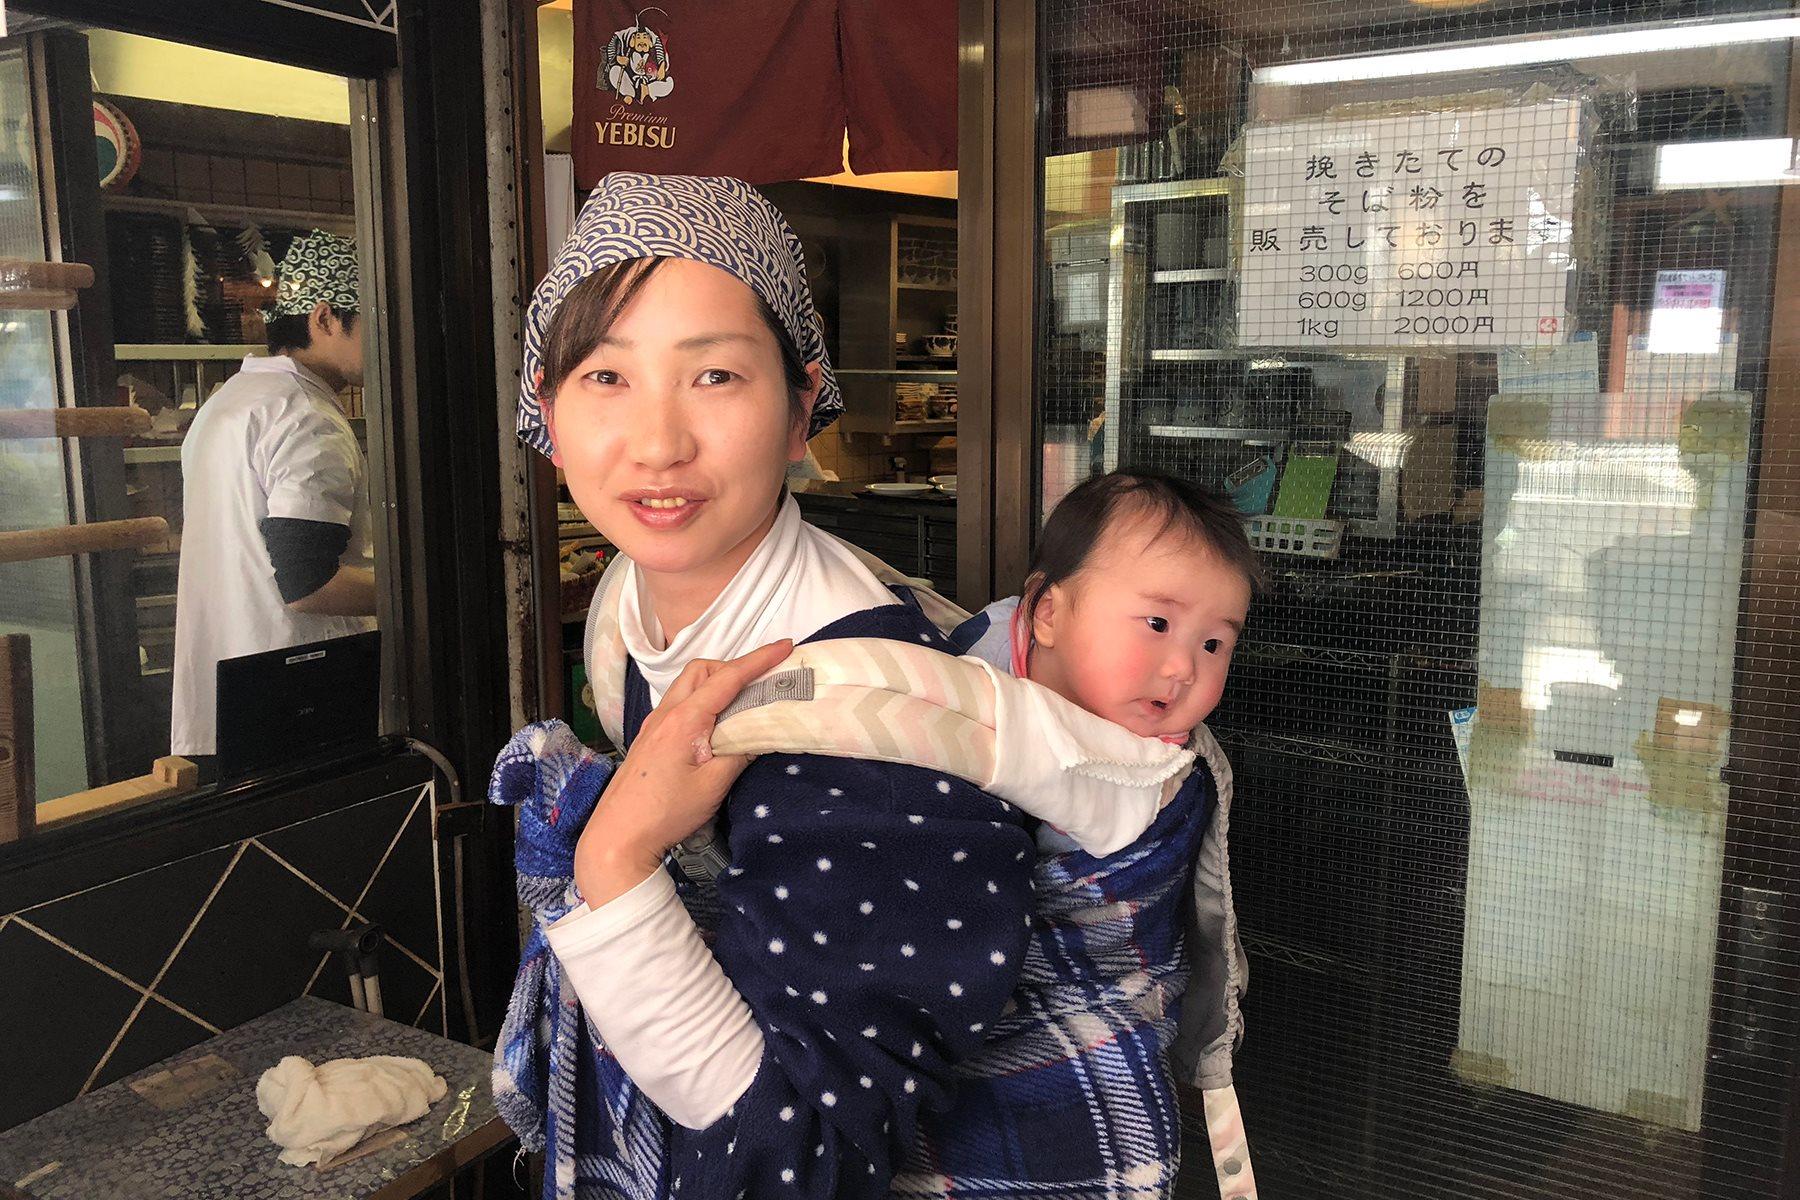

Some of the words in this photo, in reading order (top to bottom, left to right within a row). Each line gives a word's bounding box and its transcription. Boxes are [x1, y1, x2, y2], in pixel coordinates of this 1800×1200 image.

[606, 103, 669, 124] Premium
[594, 121, 677, 149] YEBISU
[1304, 147, 1506, 181] 挽きたての
[1318, 181, 1487, 215] そば粉を
[1299, 264, 1369, 285] 300g
[1398, 261, 1479, 280] 600円
[1298, 290, 1367, 312] 600g
[1395, 288, 1489, 307] 1200円
[1297, 317, 1339, 339] 1kg
[1394, 316, 1495, 334] 2000円
